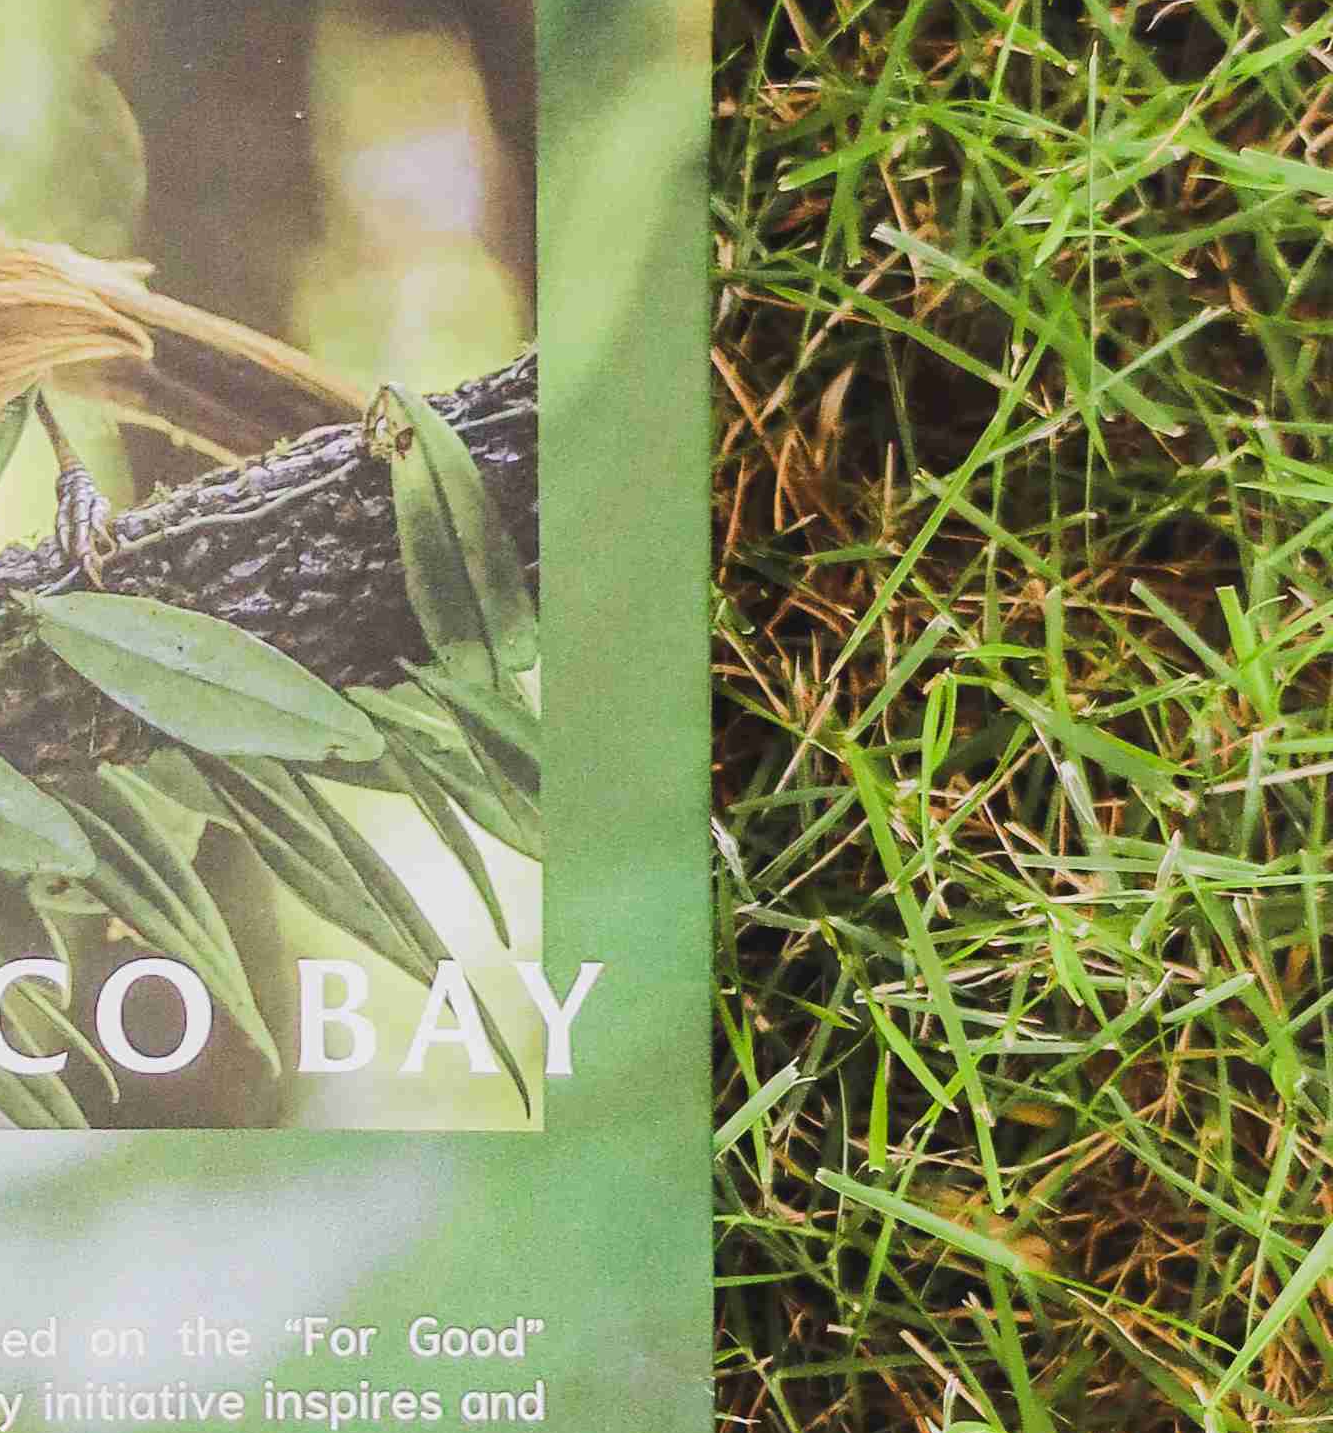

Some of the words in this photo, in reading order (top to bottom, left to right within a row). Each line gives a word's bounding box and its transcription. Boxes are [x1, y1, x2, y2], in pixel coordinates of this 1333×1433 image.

[296, 958, 604, 1076] BAY
[89, 1324, 160, 1359] on
[175, 1315, 253, 1358] the
[42, 1380, 245, 1422] initiative
[263, 1379, 444, 1433] inspires
[459, 1379, 547, 1425] and
